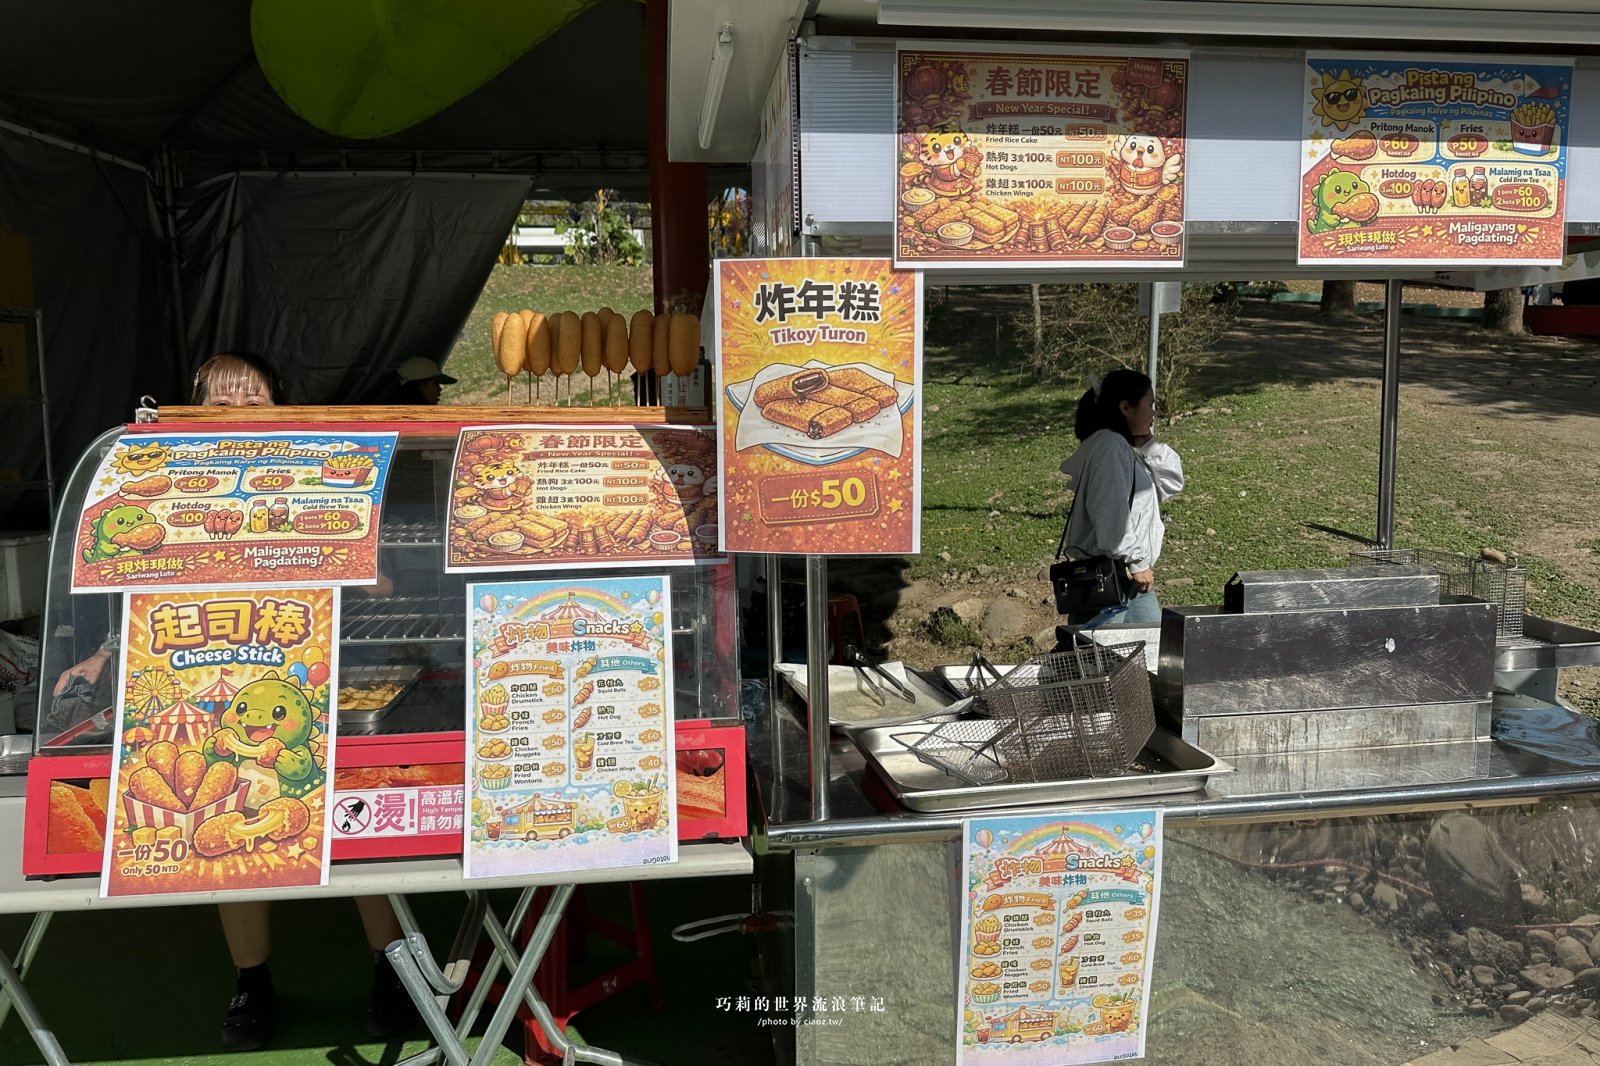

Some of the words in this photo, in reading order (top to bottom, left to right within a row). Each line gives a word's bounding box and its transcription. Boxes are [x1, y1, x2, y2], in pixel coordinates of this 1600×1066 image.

[985, 66, 1102, 98] 春節限定
[1406, 70, 1448, 86] Pista
[1453, 73, 1475, 87] ng
[1368, 85, 1446, 105] Pagkaing
[1450, 85, 1516, 106] Pilipino
[995, 103, 1019, 113] New
[1021, 103, 1045, 113] Year
[1047, 103, 1090, 115] Special!
[1390, 108, 1425, 117] Pagkaing
[1427, 107, 1447, 116] Kalye
[1449, 108, 1459, 116] ng
[1460, 108, 1493, 117] Pilipinas
[985, 123, 1020, 135] 炸年糕
[1371, 122, 1403, 133] Pritong
[1405, 123, 1435, 133] Manok
[1460, 124, 1484, 133] Fries
[985, 151, 1009, 162] 熱狗
[1381, 169, 1417, 180] Hotdog
[1489, 168, 1522, 177] Malamig
[1534, 168, 1551, 176] Tsaa
[985, 178, 1009, 189] 雞翅
[1013, 190, 1034, 198] Wings
[1449, 222, 1516, 235] Maligayang
[1338, 231, 1397, 246] 現炸現做
[1458, 233, 1519, 245] Pagdating!
[1346, 244, 1375, 253] Sariwang
[755, 280, 880, 323] 炸年糕
[770, 326, 815, 345] Tikoy
[819, 325, 866, 343] Turon
[218, 441, 263, 450] Pista
[267, 441, 289, 450] ng
[538, 434, 644, 449] 春節限定
[174, 448, 257, 460] Pagkaing
[260, 447, 331, 459] Pilipino
[595, 450, 633, 458] Special!
[168, 469, 205, 477] Pritong
[771, 477, 866, 509] 一份$50
[171, 501, 212, 511] Hotdog
[292, 497, 330, 505] Malamig
[244, 545, 320, 559] Maligayang
[116, 557, 183, 574] 現炸現做
[253, 555, 324, 569] Pagdating!
[125, 571, 159, 580] Sariwang
[151, 600, 311, 653] 起司棒
[506, 624, 549, 643] 炸物
[573, 618, 630, 636] Snacks
[545, 640, 596, 653] 美味炸物
[171, 649, 232, 668] Cheese
[237, 645, 283, 664] Stick
[510, 662, 533, 673] 炸物
[533, 664, 555, 672] Fried
[601, 658, 620, 668] 其他
[622, 659, 646, 667] Others
[373, 793, 416, 833] 燙!
[118, 839, 188, 862] 一份50
[1066, 853, 1121, 870] Snacks
[122, 866, 143, 875] Only
[145, 864, 161, 874] 50
[162, 865, 179, 873] NTD
[1039, 874, 1087, 887] 美味炸物
